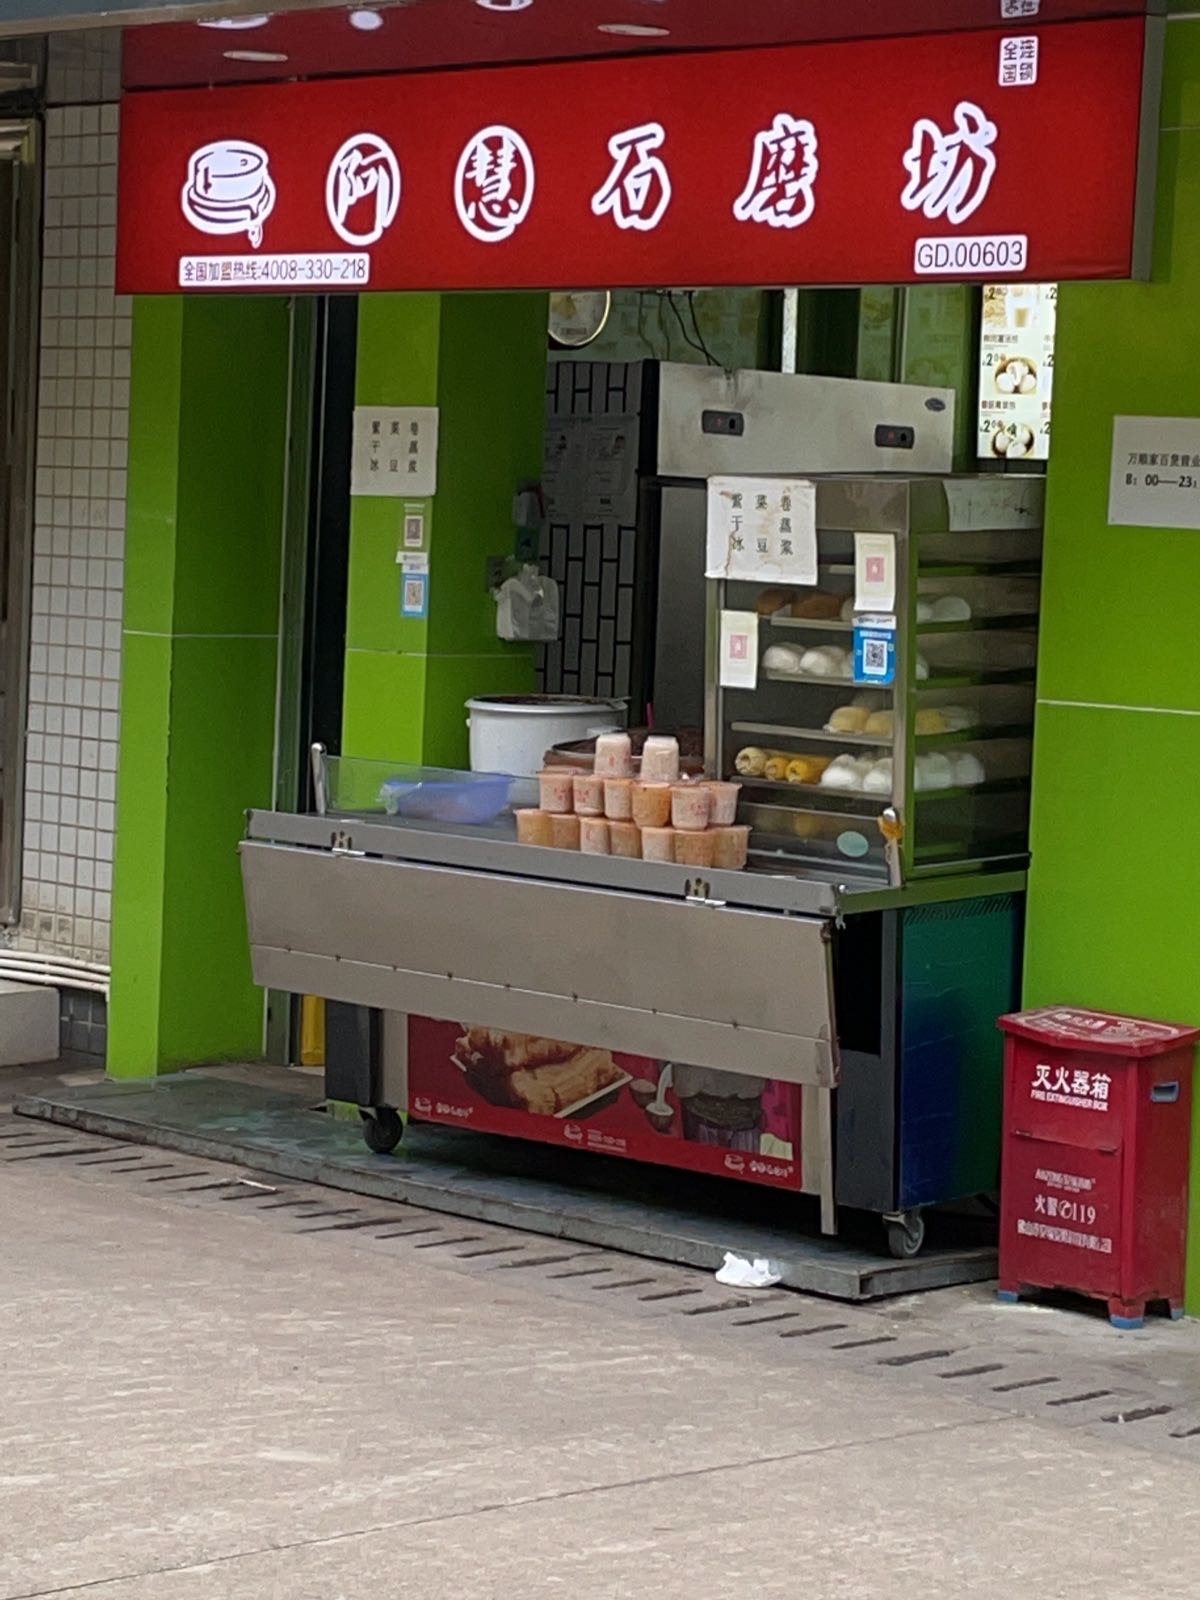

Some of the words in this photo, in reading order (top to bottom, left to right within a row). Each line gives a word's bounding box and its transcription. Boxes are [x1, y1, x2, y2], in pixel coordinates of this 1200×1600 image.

[917, 242, 1024, 270] GD.00603
[1031, 1064, 1112, 1100] 灭火器箱
